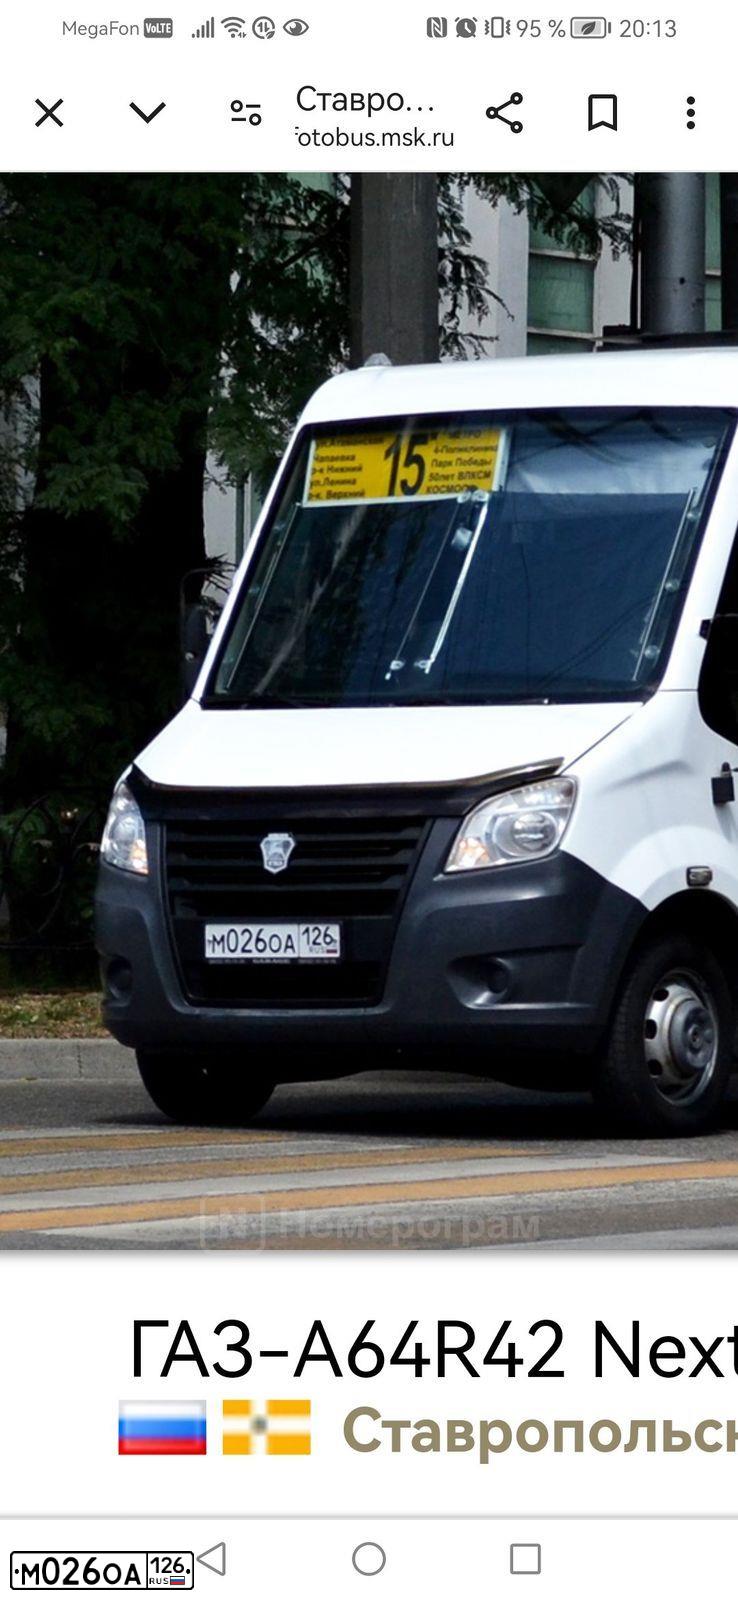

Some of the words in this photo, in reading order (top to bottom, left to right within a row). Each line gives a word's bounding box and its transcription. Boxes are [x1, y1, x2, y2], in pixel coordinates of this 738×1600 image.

[62, 20, 139, 39] MegaFon
[145, 22, 172, 35] VoLTE
[516, 19, 541, 38] 95
[548, 19, 566, 38] %
[619, 19, 677, 38] 20:13
[301, 926, 335, 946] 126
